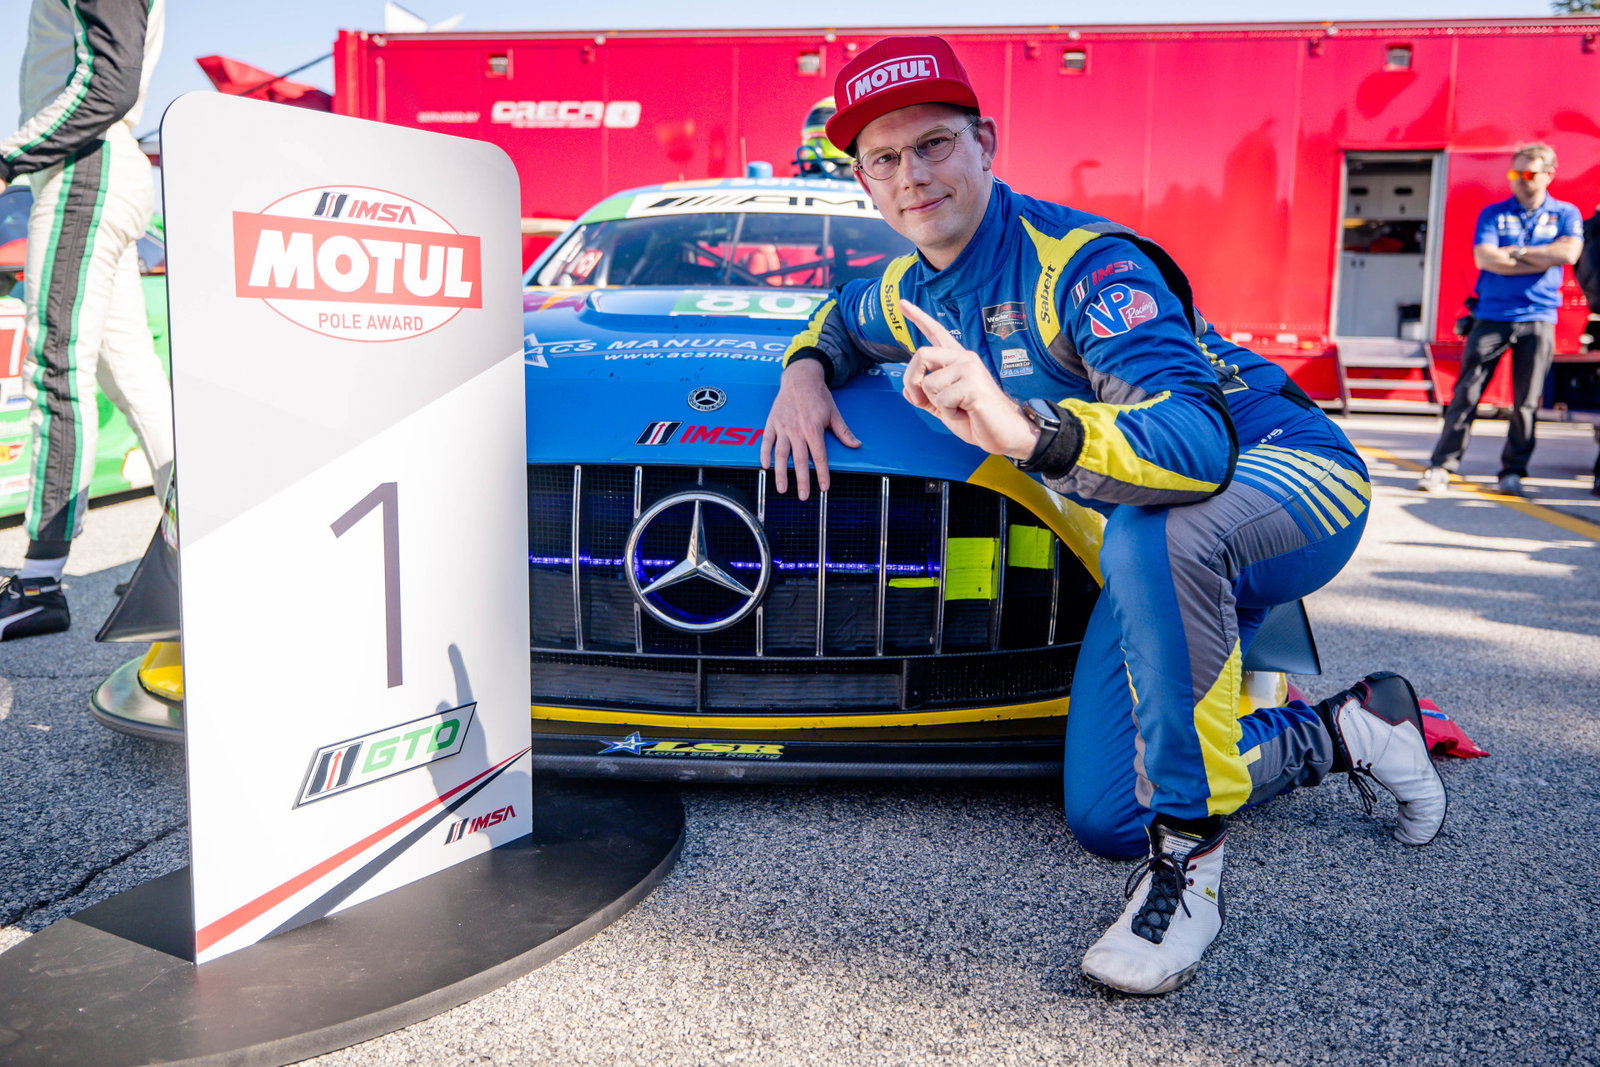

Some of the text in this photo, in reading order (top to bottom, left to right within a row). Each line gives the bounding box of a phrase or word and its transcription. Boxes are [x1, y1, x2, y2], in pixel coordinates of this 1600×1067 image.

[855, 60, 931, 100] MOTUL
[491, 101, 605, 123] ORECA
[347, 199, 417, 225] IMSA
[736, 195, 880, 211] AM
[248, 229, 473, 298] MOTUL
[1091, 259, 1143, 286] IMSA
[695, 292, 812, 314] 80
[885, 284, 903, 331] Sabelt
[1040, 263, 1057, 325] Sabelt
[318, 312, 425, 332] POLE AWARD
[1085, 283, 1135, 335] VP
[1125, 299, 1155, 324] Racing
[329, 481, 404, 689] 1
[361, 718, 461, 775] GTD
[642, 741, 785, 755] LSR
[725, 752, 781, 760] Racing
[468, 804, 517, 835] IMSA
